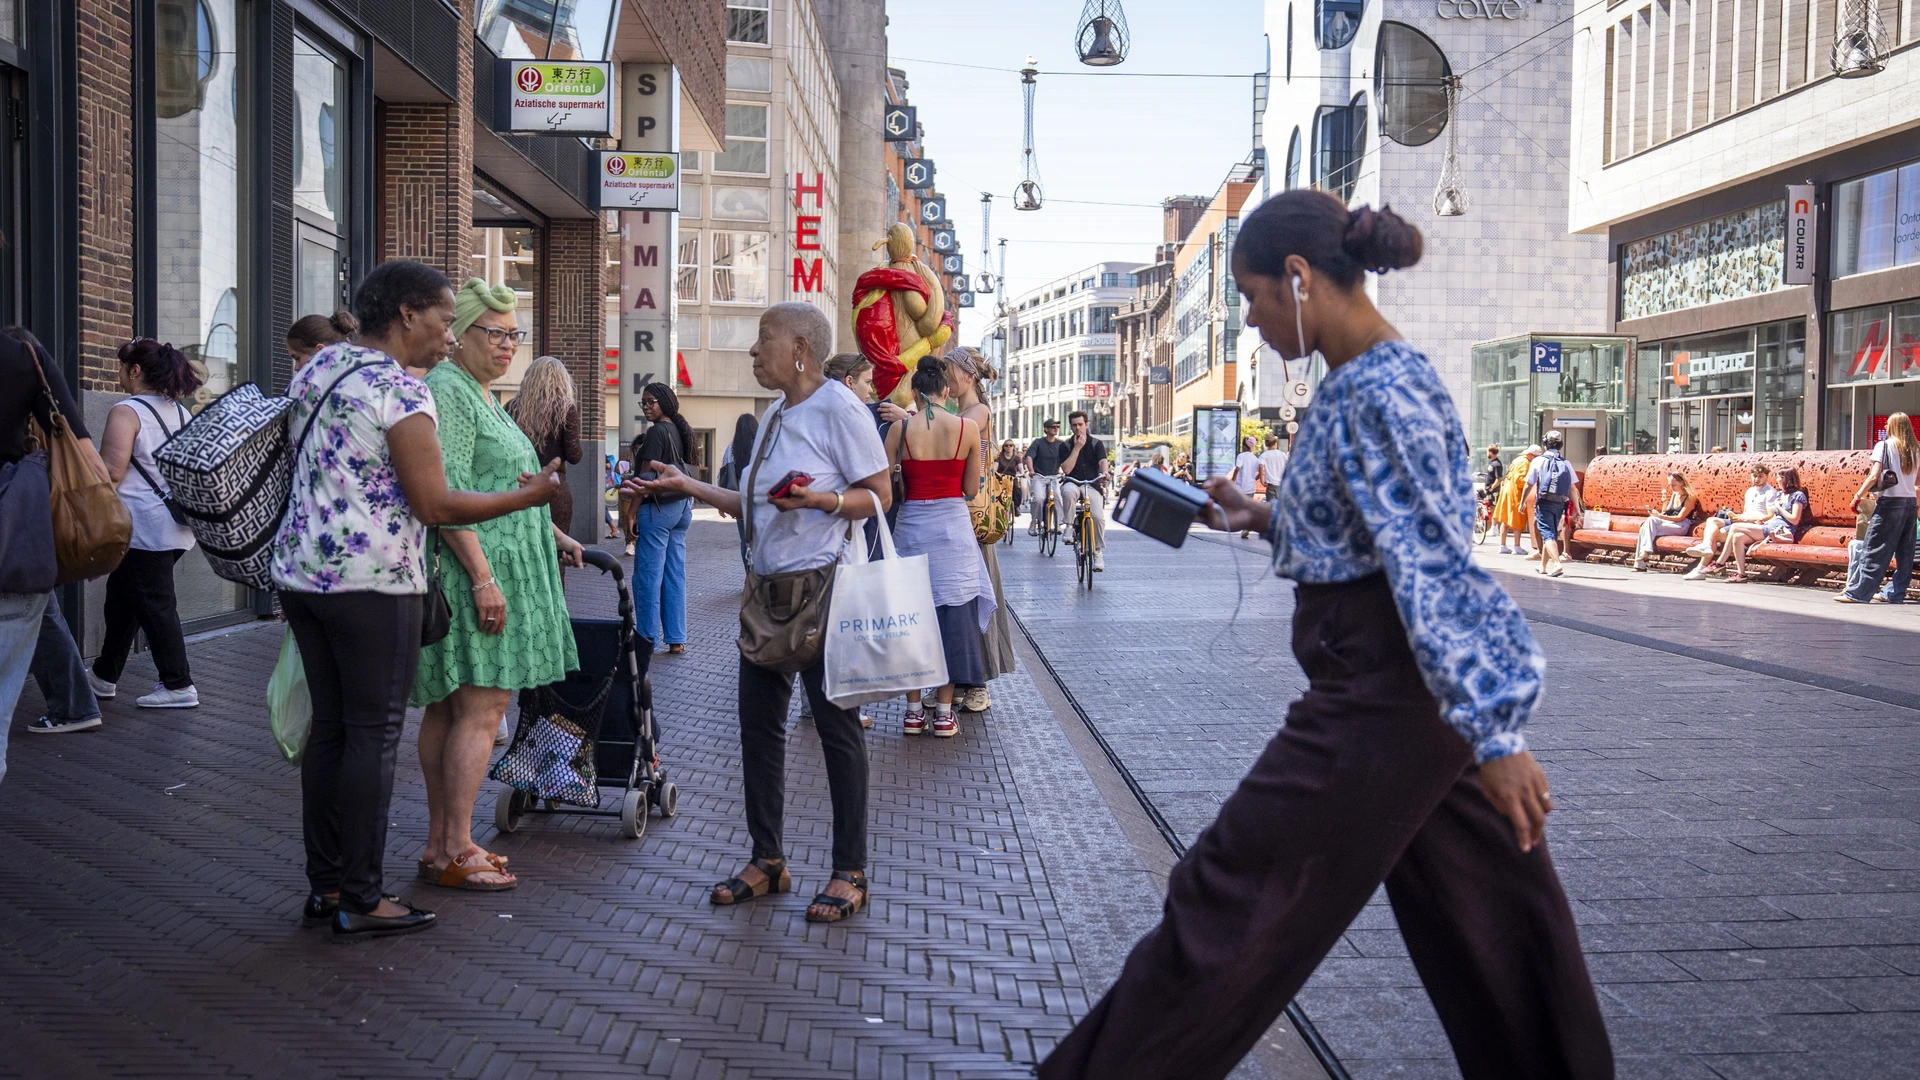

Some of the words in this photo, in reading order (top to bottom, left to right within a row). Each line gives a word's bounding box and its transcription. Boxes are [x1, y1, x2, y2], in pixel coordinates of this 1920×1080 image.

[552, 67, 591, 80] 東方行
[545, 83, 596, 93] Oriental
[515, 98, 557, 108] Aziatische
[559, 100, 605, 110] supermarkt
[633, 157, 664, 167] 東方行
[628, 168, 668, 177] Oriental
[604, 180, 637, 188] Aziatische
[639, 182, 675, 190] supermarkt
[793, 172, 823, 302] HEM
[1796, 218, 1806, 270] COURIR
[1535, 347, 1546, 365] P
[1690, 353, 1747, 376] COURIR
[1294, 382, 1308, 397] G
[854, 634, 870, 642] LOVE
[885, 630, 910, 639] FEELING
[885, 673, 909, 681] RECYCLED
